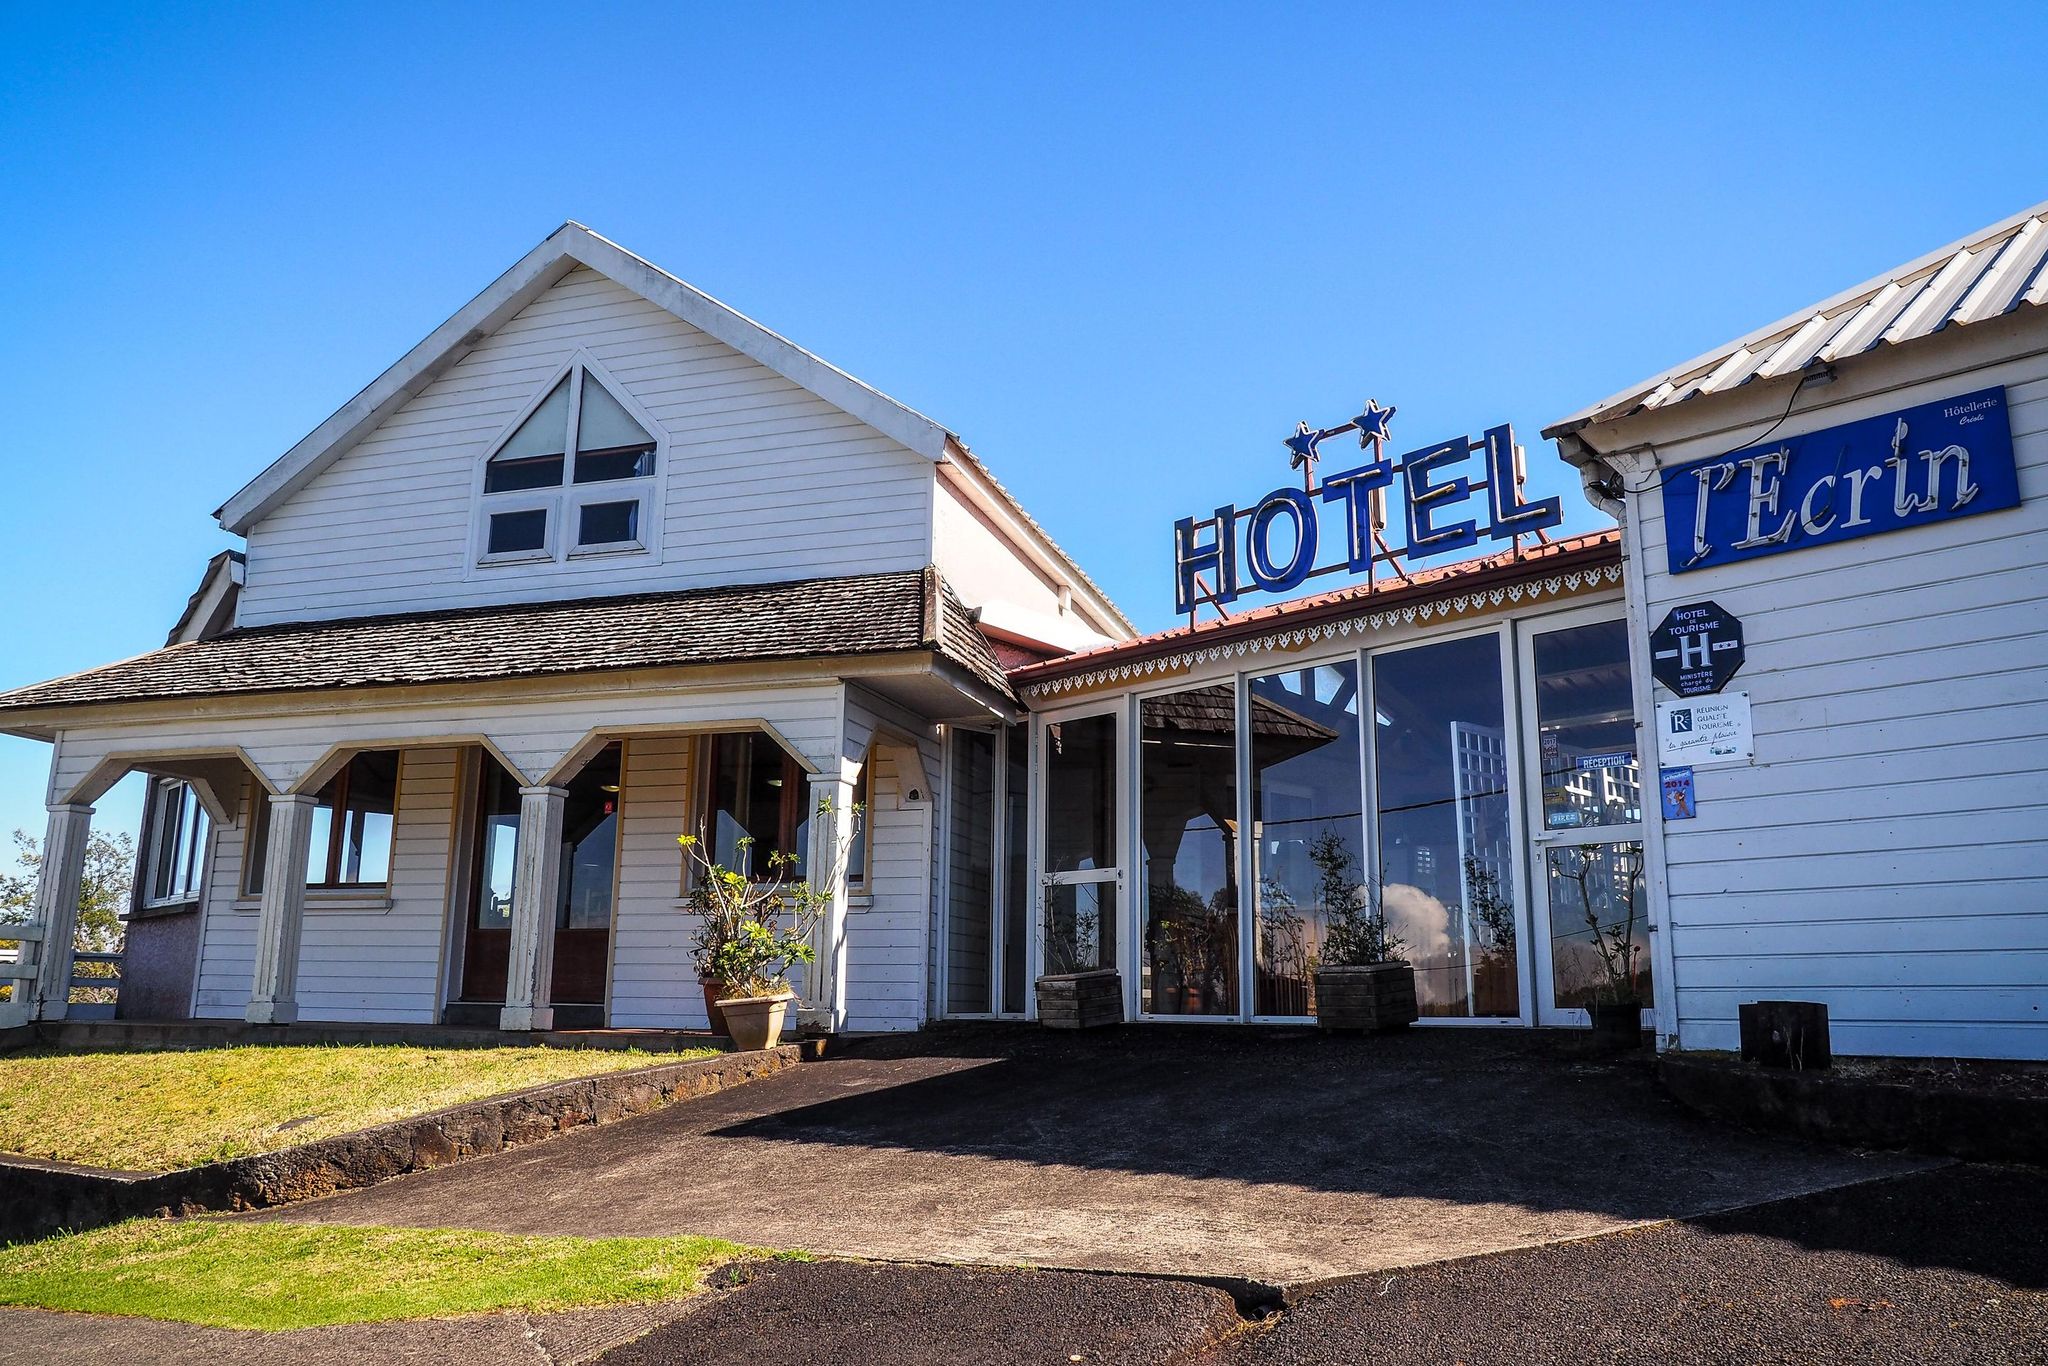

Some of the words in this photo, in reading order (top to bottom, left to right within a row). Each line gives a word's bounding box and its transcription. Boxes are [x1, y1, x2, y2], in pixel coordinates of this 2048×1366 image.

[1944, 398, 1997, 418] Hôtellerie
[1174, 422, 1562, 615] HOTEL
[1676, 609, 1709, 621] HOTEL
[1668, 620, 1720, 636] TOURISME
[1679, 632, 1713, 669] H
[1683, 684, 1712, 694] TOURISME
[1583, 754, 1625, 769] RÉCEPTION
[1664, 780, 1690, 789] 2014
